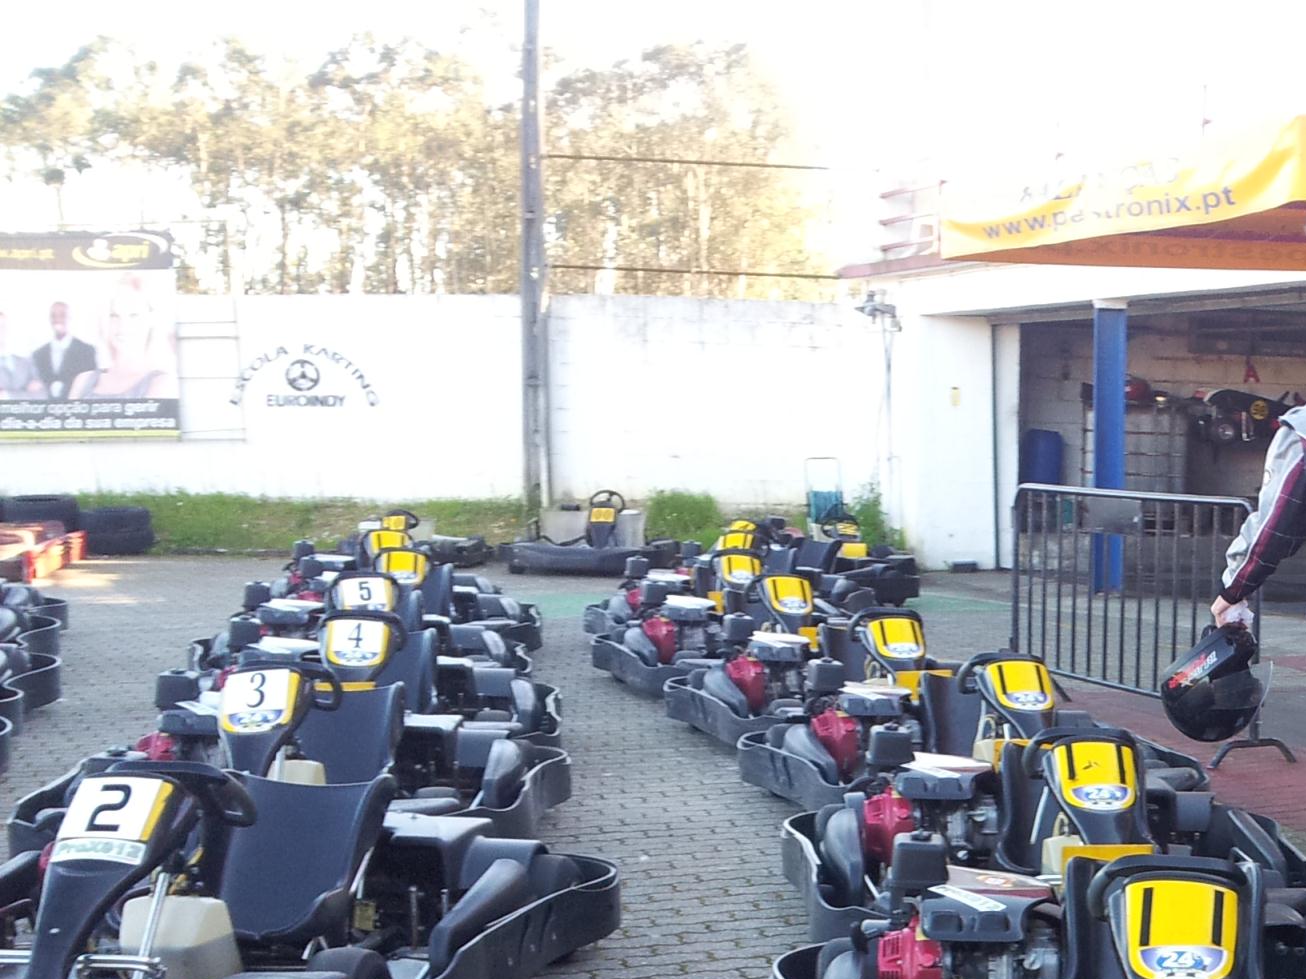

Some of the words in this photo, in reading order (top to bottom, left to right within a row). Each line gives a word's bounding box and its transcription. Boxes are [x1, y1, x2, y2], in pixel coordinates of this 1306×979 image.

[266, 394, 345, 408] EUROINDY
[358, 581, 372, 601] 5
[347, 622, 363, 648] 4
[246, 672, 266, 708] 3
[85, 784, 132, 832] 2
